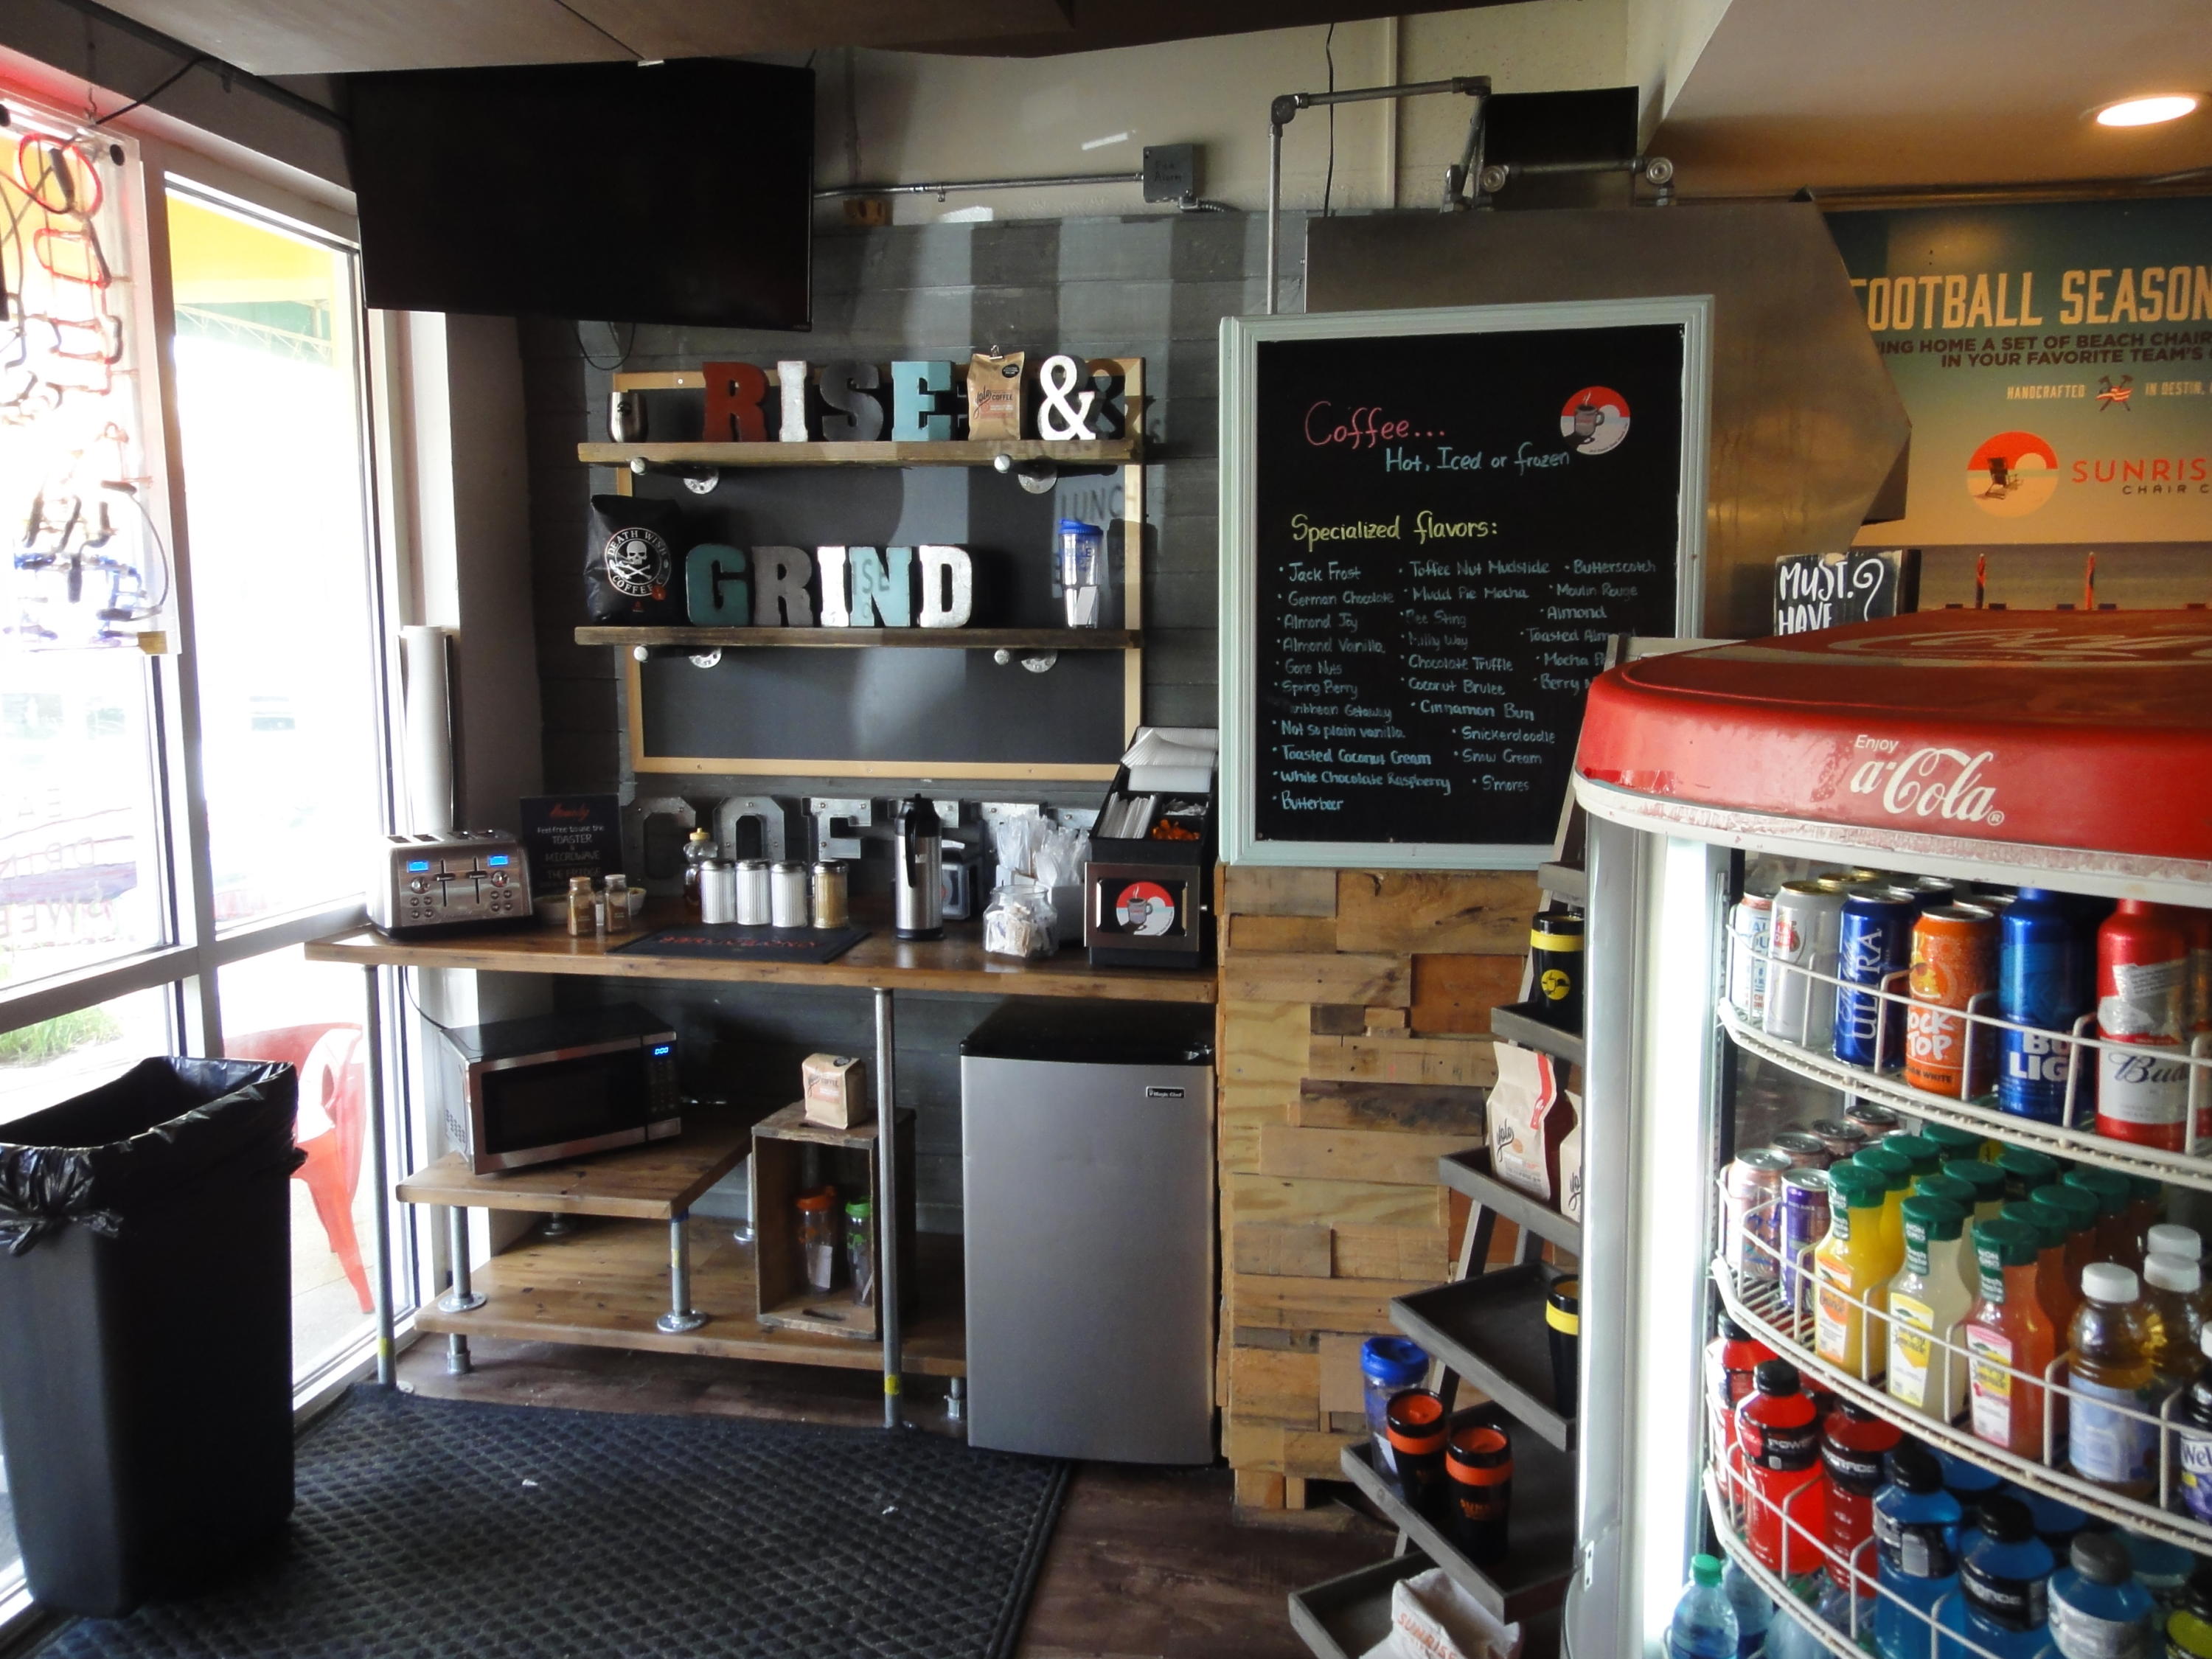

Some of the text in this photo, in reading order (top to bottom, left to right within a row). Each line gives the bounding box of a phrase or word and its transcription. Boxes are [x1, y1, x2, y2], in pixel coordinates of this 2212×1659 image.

[1879, 339, 1915, 358] ING
[1919, 338, 1977, 355] HOME
[1981, 338, 1996, 353] A
[2002, 335, 2038, 352] SET
[2043, 334, 2070, 350] OF
[2076, 333, 2144, 349] BEACH
[1941, 354, 1960, 368] IN
[1963, 351, 2021, 368] YOUR
[2026, 348, 2124, 366] FAVORITE
[2130, 346, 2204, 364] TEAM'S
[701, 354, 1097, 442] RISE &
[992, 393, 1014, 401] COFFEE
[2006, 384, 2086, 400] HANDCRAFTED
[2145, 382, 2158, 396] IN
[1437, 446, 1482, 472] Iced
[1491, 452, 1508, 470] or
[1514, 442, 1571, 476] frozen
[2122, 483, 2188, 496] CHAIR
[1291, 509, 1498, 552] Specialized flavors:
[607, 529, 639, 556] DEATH
[1288, 560, 1363, 582] Jack Frost
[1408, 558, 1552, 578] Toffee Nut Mudslide
[1573, 558, 1658, 575] Butterscotch
[612, 574, 654, 595] COFFEE
[684, 543, 973, 628] GRIND
[1458, 585, 1478, 600] Pie
[1484, 585, 1531, 600] Mocha
[1556, 581, 1639, 602] Moulin Rouge
[1287, 590, 1396, 607] German Chocolate
[1283, 611, 1360, 633] Almond Joy
[1433, 608, 1468, 628] Sting
[1546, 605, 1607, 620] Almond
[1281, 636, 1386, 654] Almond Vanilla
[1444, 632, 1470, 650] Way
[1526, 627, 1580, 643] Toasted
[1284, 658, 1343, 675] Gone Nuts
[1408, 653, 1515, 672] Chocolate Truffle
[1543, 652, 1590, 667] Mocha
[1280, 678, 1359, 700] Spring Berry
[1408, 676, 1506, 696] Coconut Brulee
[1540, 672, 1580, 696] Berry
[1287, 702, 1394, 723] aribbean Getaway
[1419, 698, 1536, 722] Cinnamon Bun
[1280, 719, 1304, 737] Not
[1324, 724, 1357, 740] plain
[1461, 725, 1558, 745] Snickerdoodle
[1854, 734, 1899, 754] Enjoy
[1281, 744, 1433, 766] Toasted Coconut Cream
[1461, 748, 1543, 765] Snow Cream
[1279, 770, 1452, 796] White Chocolate Raspberry
[1481, 774, 1531, 793] S'mores
[1281, 790, 1345, 811] Butterbeer
[552, 833, 593, 844] TOASTER
[1907, 1009, 1955, 1034] OCK
[1907, 1031, 1952, 1061] TOP
[2009, 1051, 2070, 1082] LIG
[1922, 1071, 1952, 1083] WHITE
